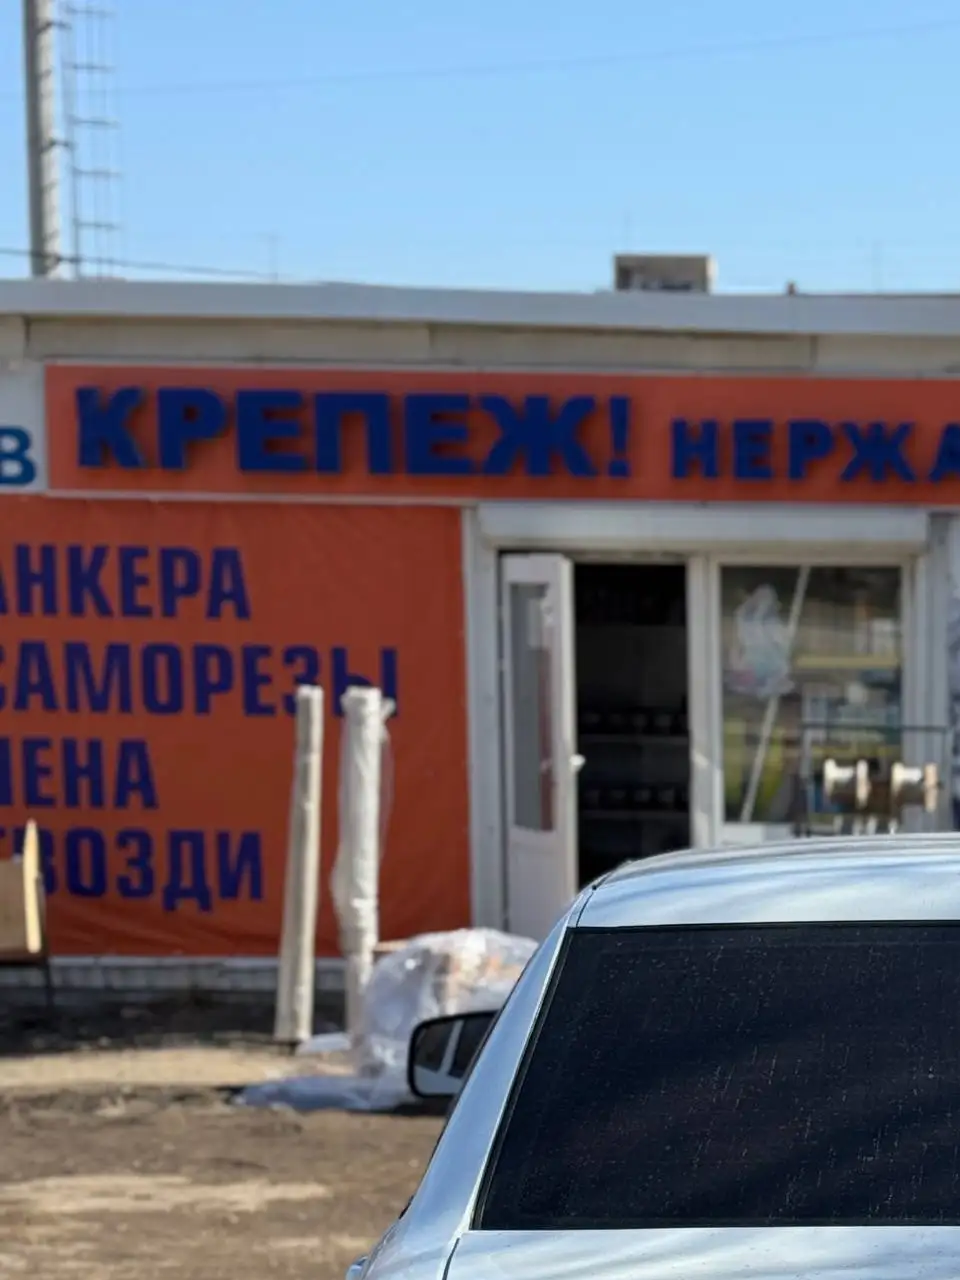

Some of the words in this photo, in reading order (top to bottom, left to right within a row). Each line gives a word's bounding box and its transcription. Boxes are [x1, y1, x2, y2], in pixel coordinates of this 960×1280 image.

[76, 386, 631, 479] КРЕПЕЖ!
[0, 543, 251, 620] НКЕРА
[0, 640, 397, 718] АМОРЕЗЫ
[0, 827, 263, 911] ВОЗДИ
